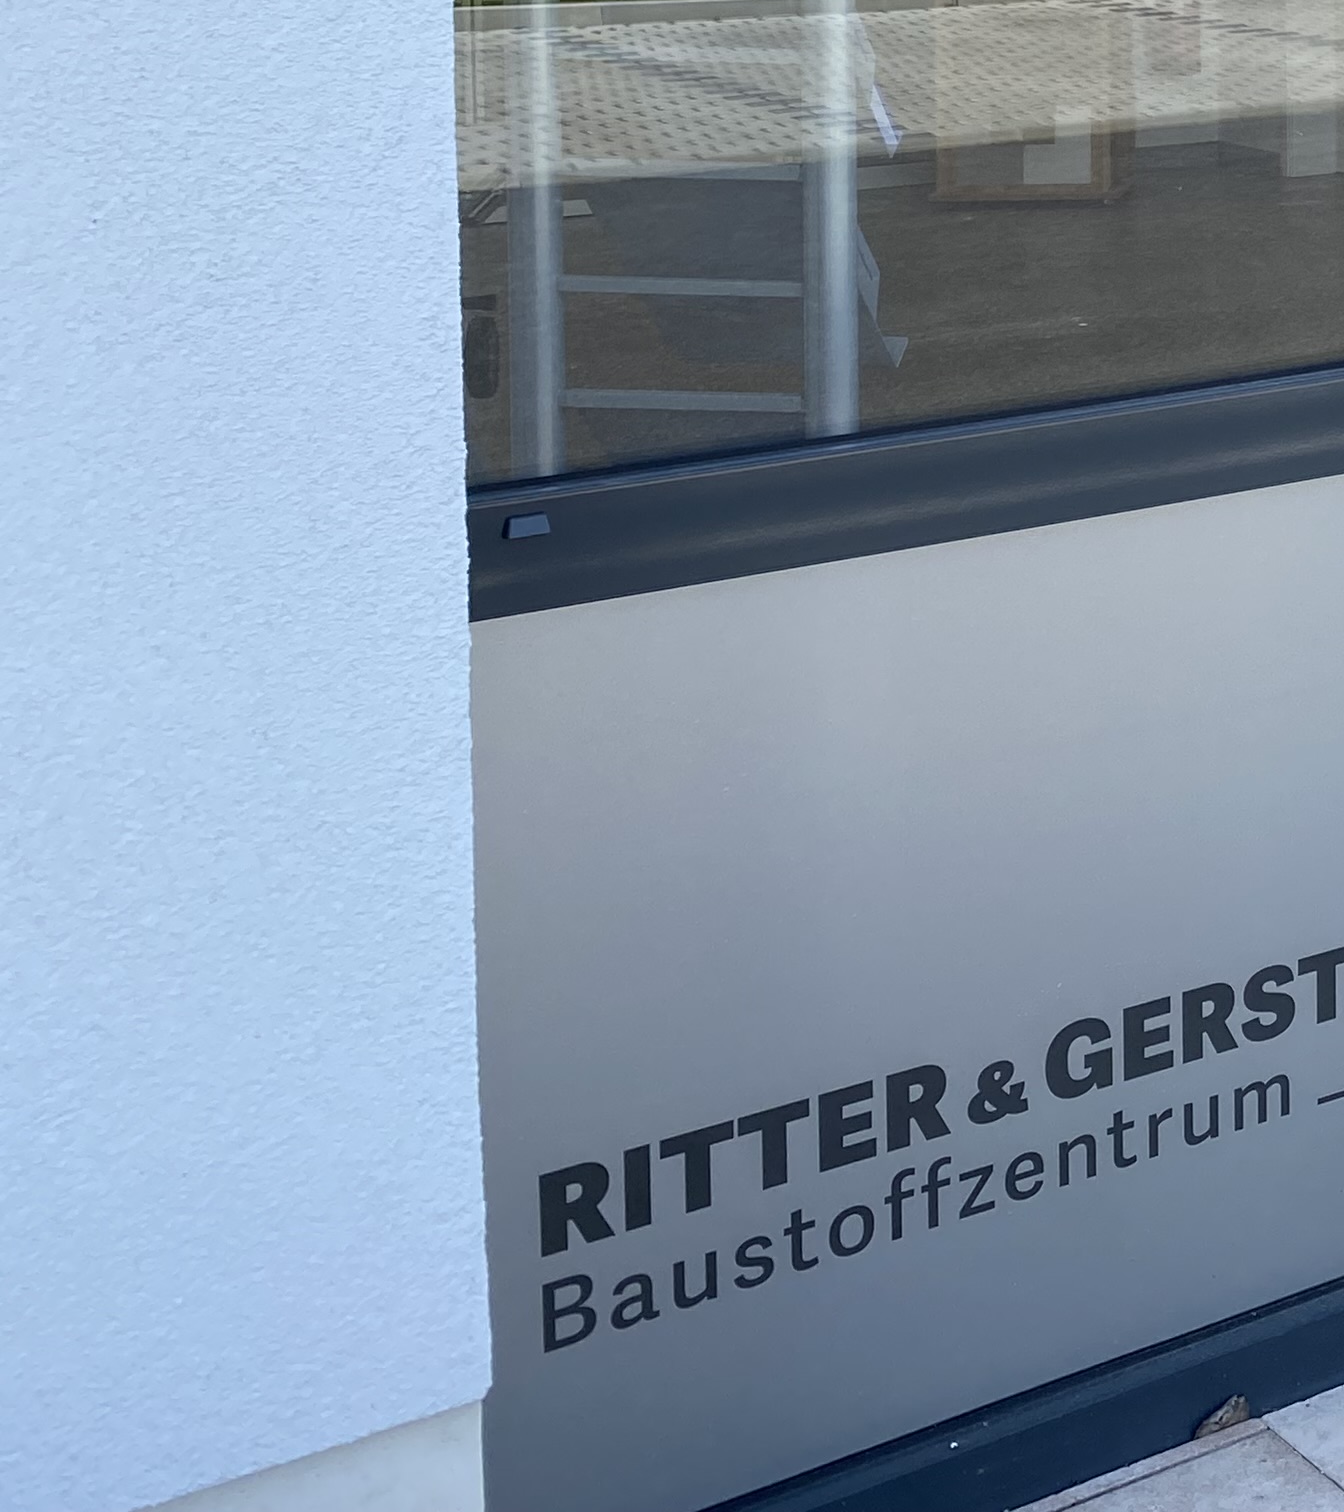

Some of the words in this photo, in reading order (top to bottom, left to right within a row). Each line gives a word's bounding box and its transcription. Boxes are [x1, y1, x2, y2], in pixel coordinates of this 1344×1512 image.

[538, 1063, 949, 1258] RITTER
[966, 1058, 1028, 1124] &
[543, 1070, 1294, 1355] Baustoffzentrum
